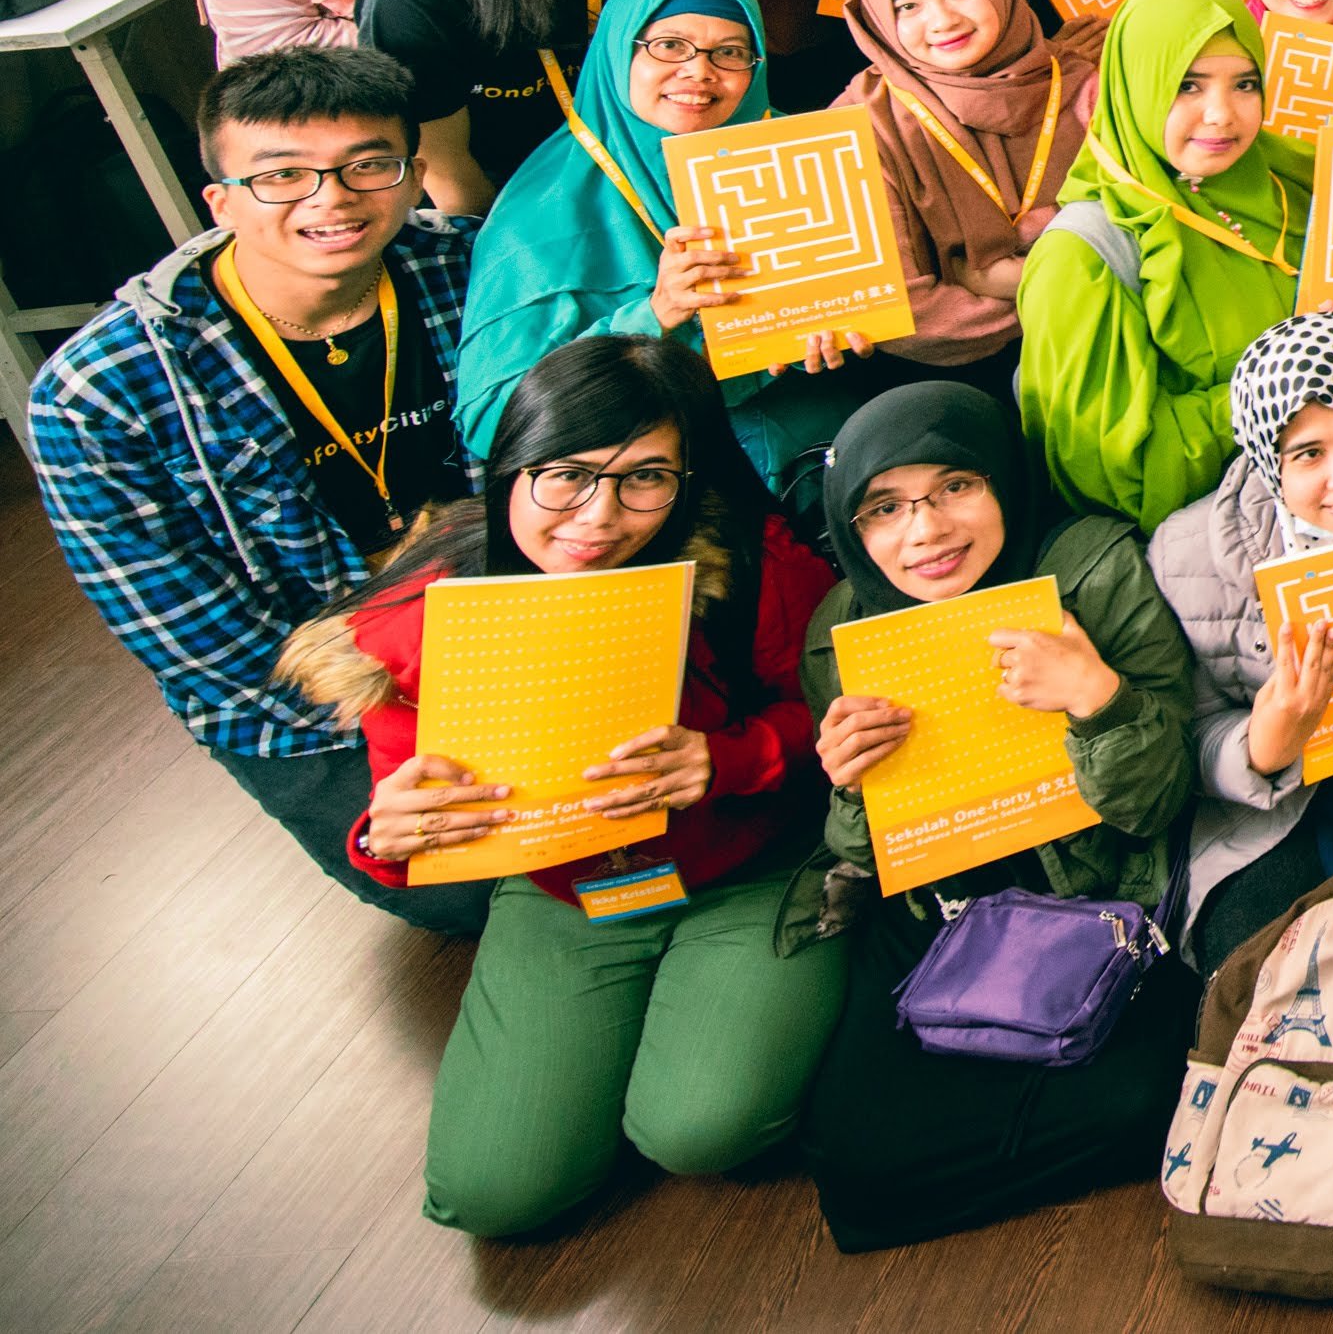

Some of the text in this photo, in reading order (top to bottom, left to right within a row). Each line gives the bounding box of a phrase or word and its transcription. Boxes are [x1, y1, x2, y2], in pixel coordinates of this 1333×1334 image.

[716, 283, 897, 333] Sekolah One-Forty 作業本
[501, 816, 555, 835] Mandarin
[884, 816, 950, 846] Sekolah
[953, 788, 1032, 824] One-Forty
[886, 841, 915, 856] Kelas
[916, 830, 951, 848] Bahasa
[953, 815, 999, 836] Mandarin
[1000, 801, 1038, 821] Sekolah
